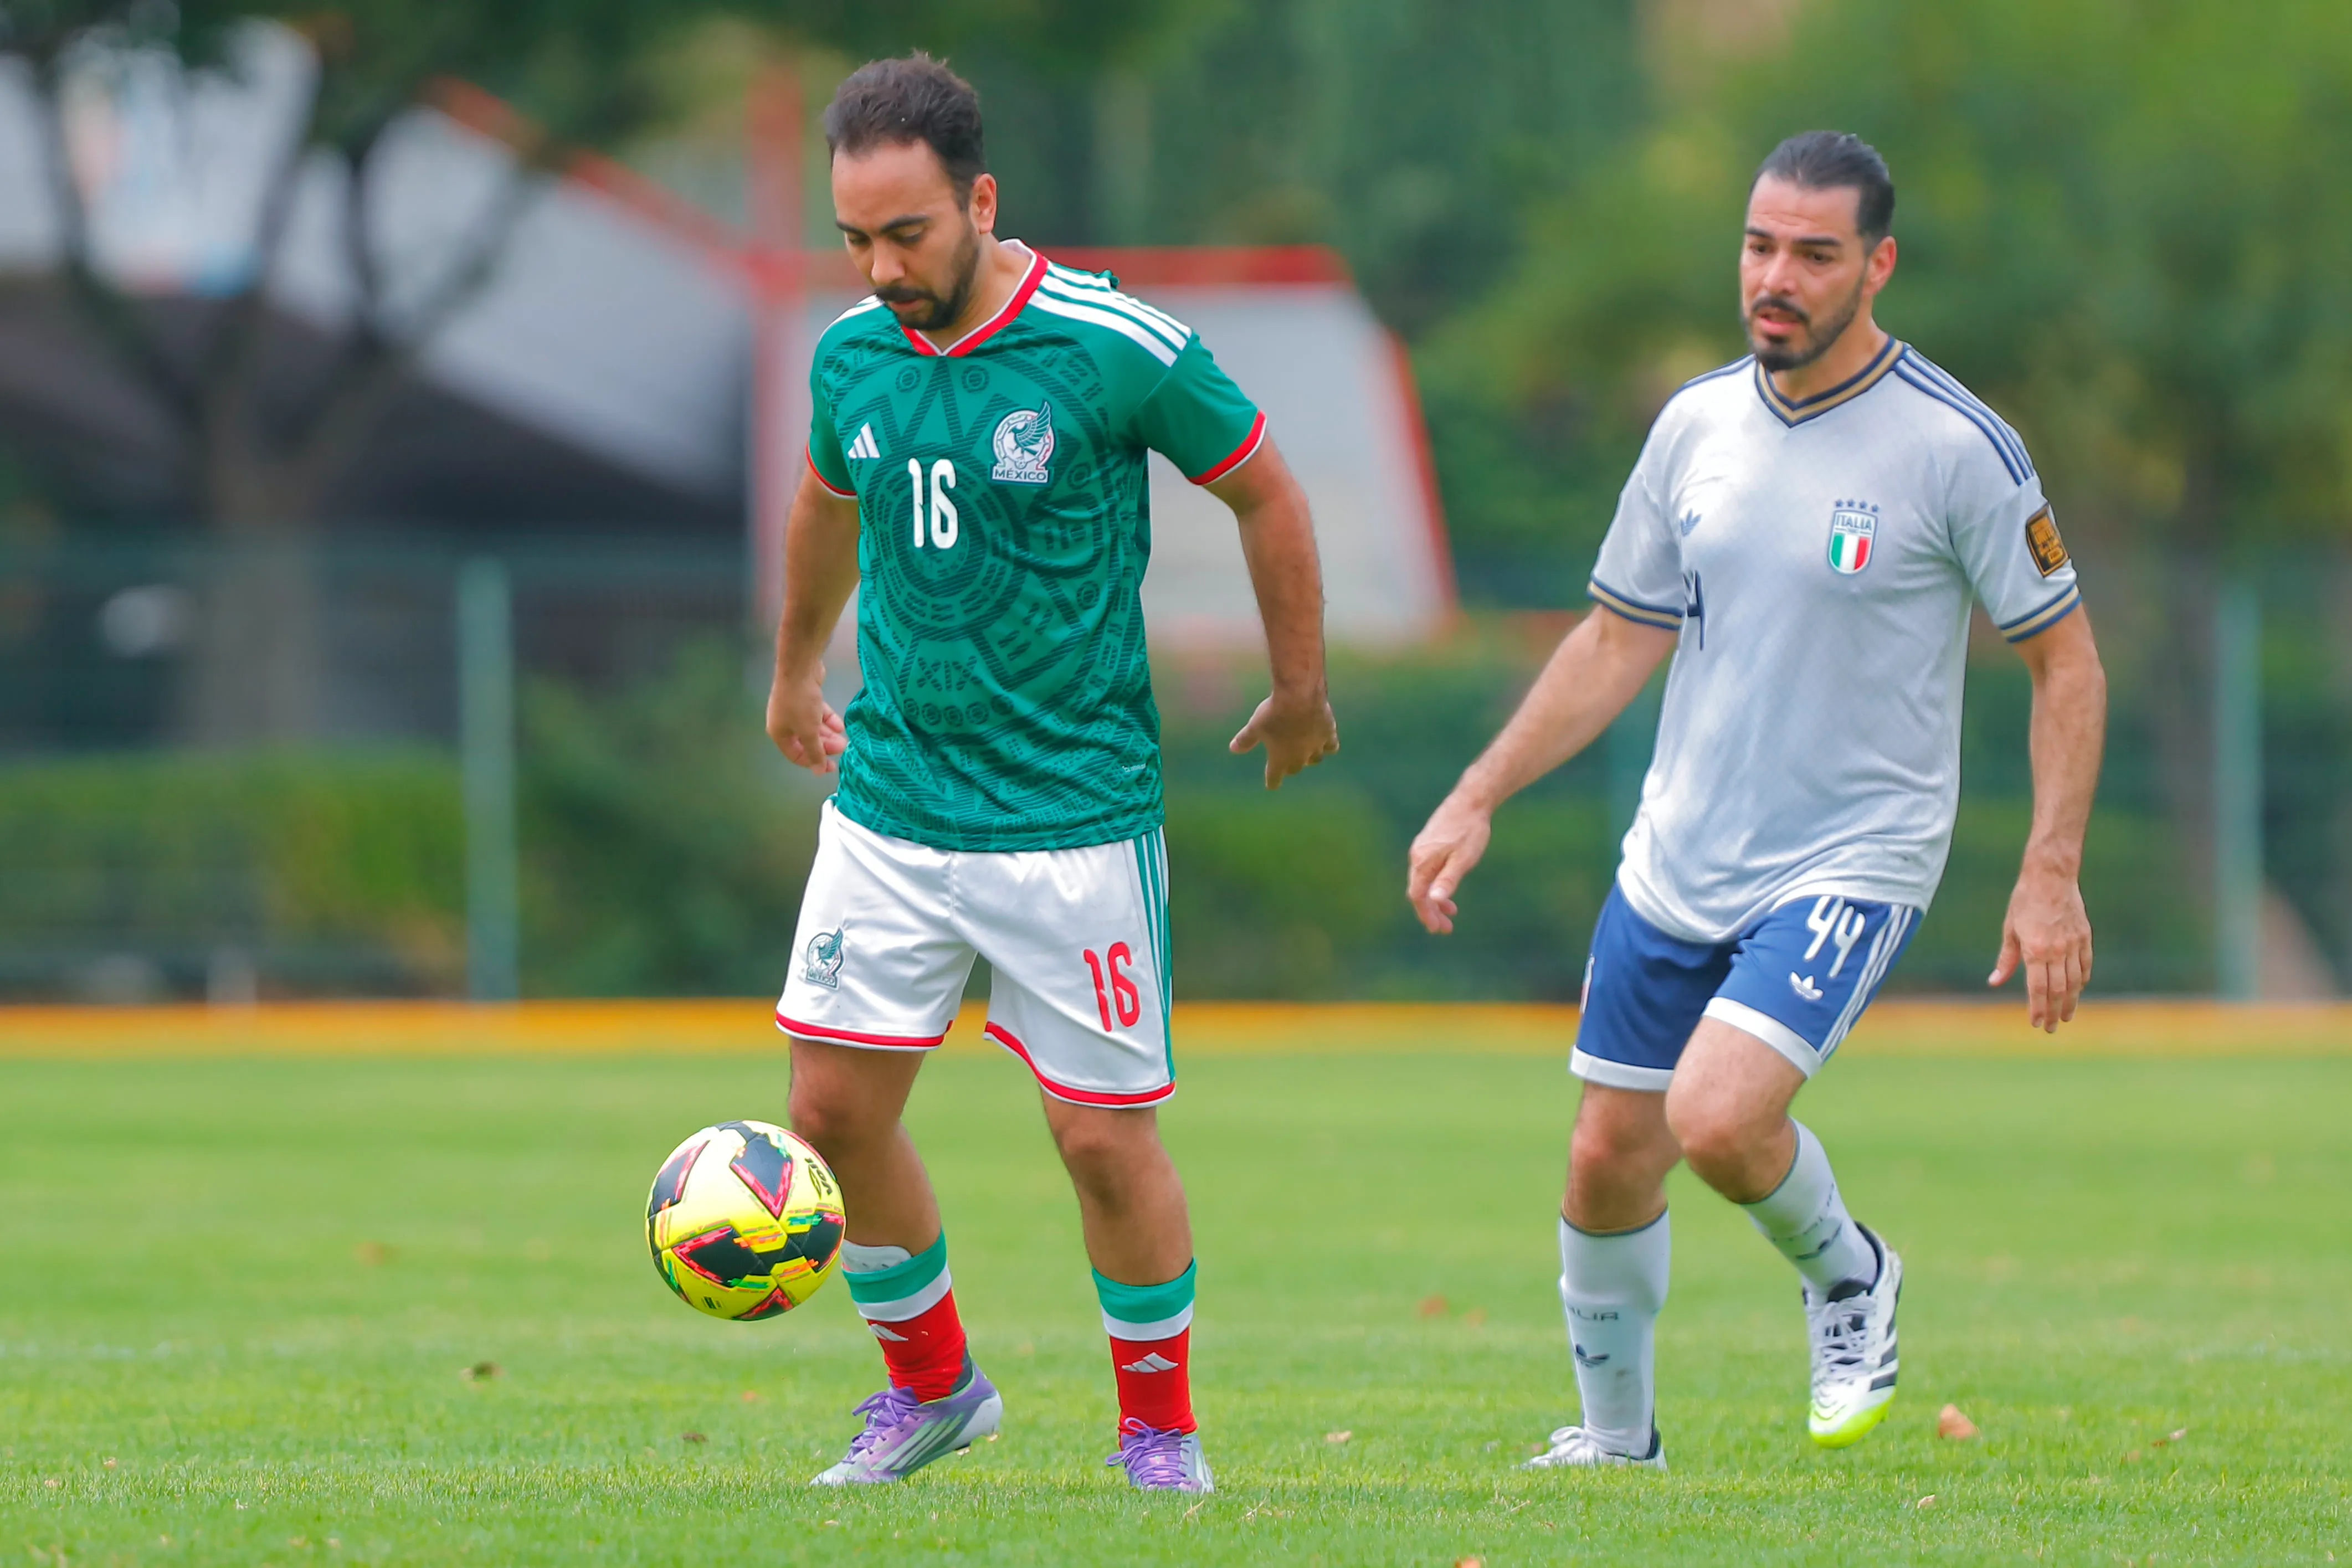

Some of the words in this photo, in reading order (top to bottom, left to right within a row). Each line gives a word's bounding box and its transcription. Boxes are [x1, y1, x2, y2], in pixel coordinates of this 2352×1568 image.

[908, 457, 958, 549] 16
[995, 468, 1046, 481] MÉXICO
[1835, 515, 1872, 531] ITALIA
[1804, 895, 1866, 978] 44
[1083, 942, 1140, 1031] 16
